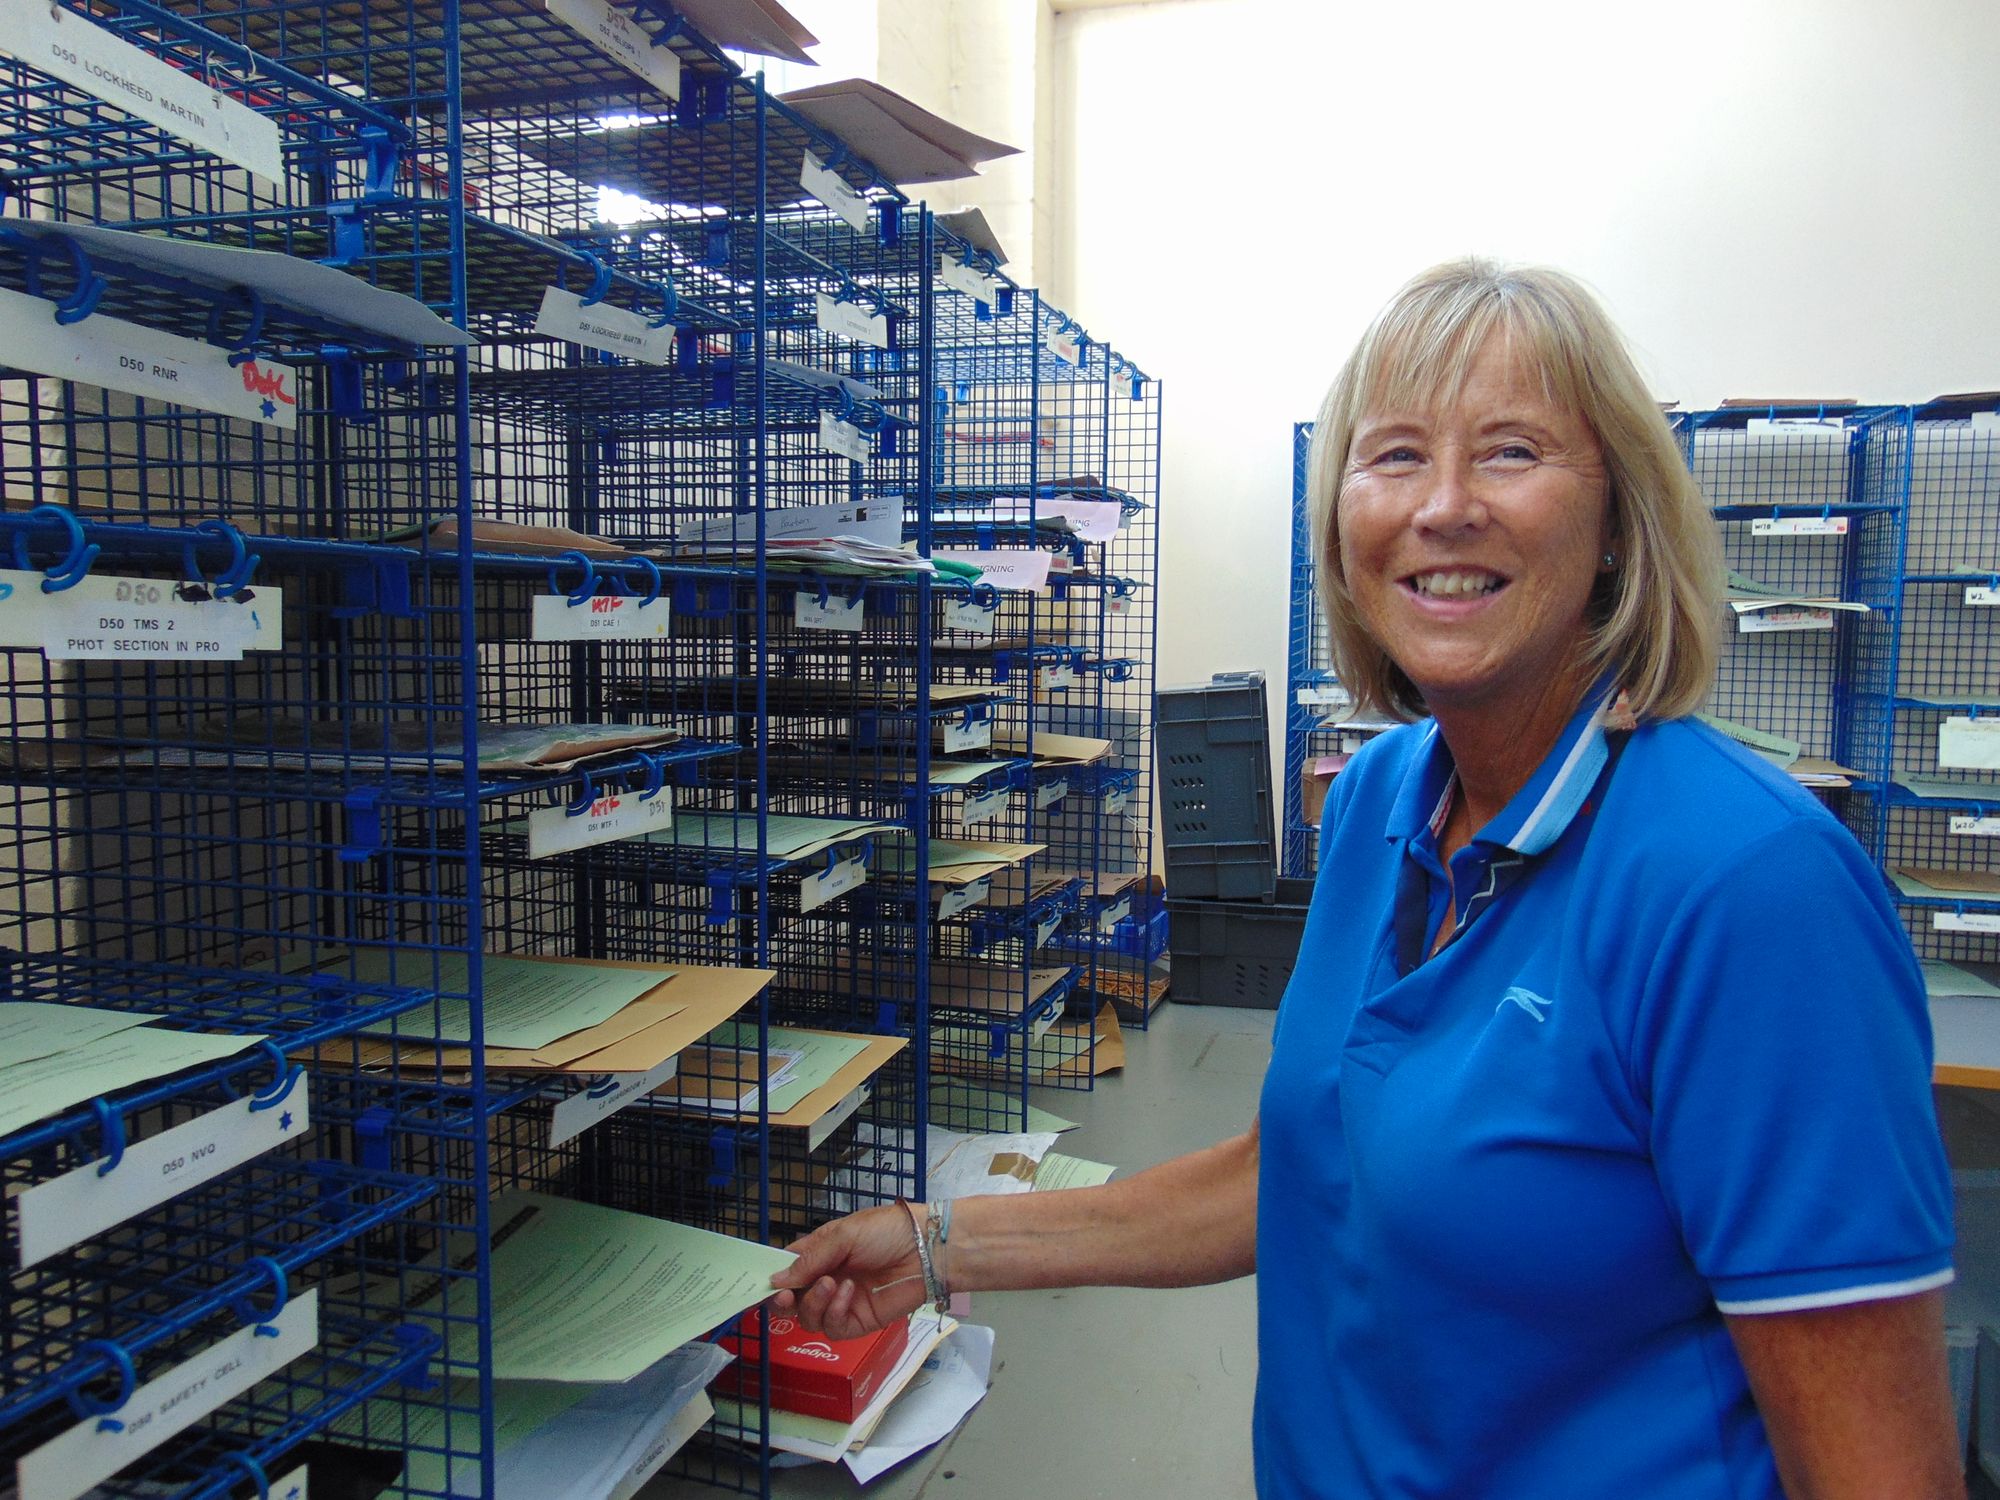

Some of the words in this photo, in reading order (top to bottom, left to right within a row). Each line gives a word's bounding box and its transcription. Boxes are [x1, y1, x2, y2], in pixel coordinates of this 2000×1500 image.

[52, 44, 77, 65] D50
[84, 60, 153, 102] LOCKHEED
[160, 97, 205, 128] MARTIN
[591, 325, 621, 340] LOCKHEED
[622, 335, 643, 345] MARTIN
[119, 355, 145, 373] D50
[152, 365, 179, 382] RNR
[116, 580, 161, 606] D50
[99, 618, 124, 630] D50
[133, 618, 159, 630] TMS
[167, 619, 175, 631] 2
[590, 619, 600, 628] D51
[602, 619, 615, 628] CAE
[67, 639, 104, 650] PHOT
[113, 639, 169, 651] SECTION
[176, 640, 189, 651] IN
[196, 640, 220, 652] PRO
[587, 823, 598, 832] D51
[600, 820, 615, 830] MTF
[162, 1157, 185, 1175] D50
[786, 1344, 840, 1362] Colgate
[160, 1377, 207, 1415] SAFETY
[214, 1358, 241, 1381] CELL
